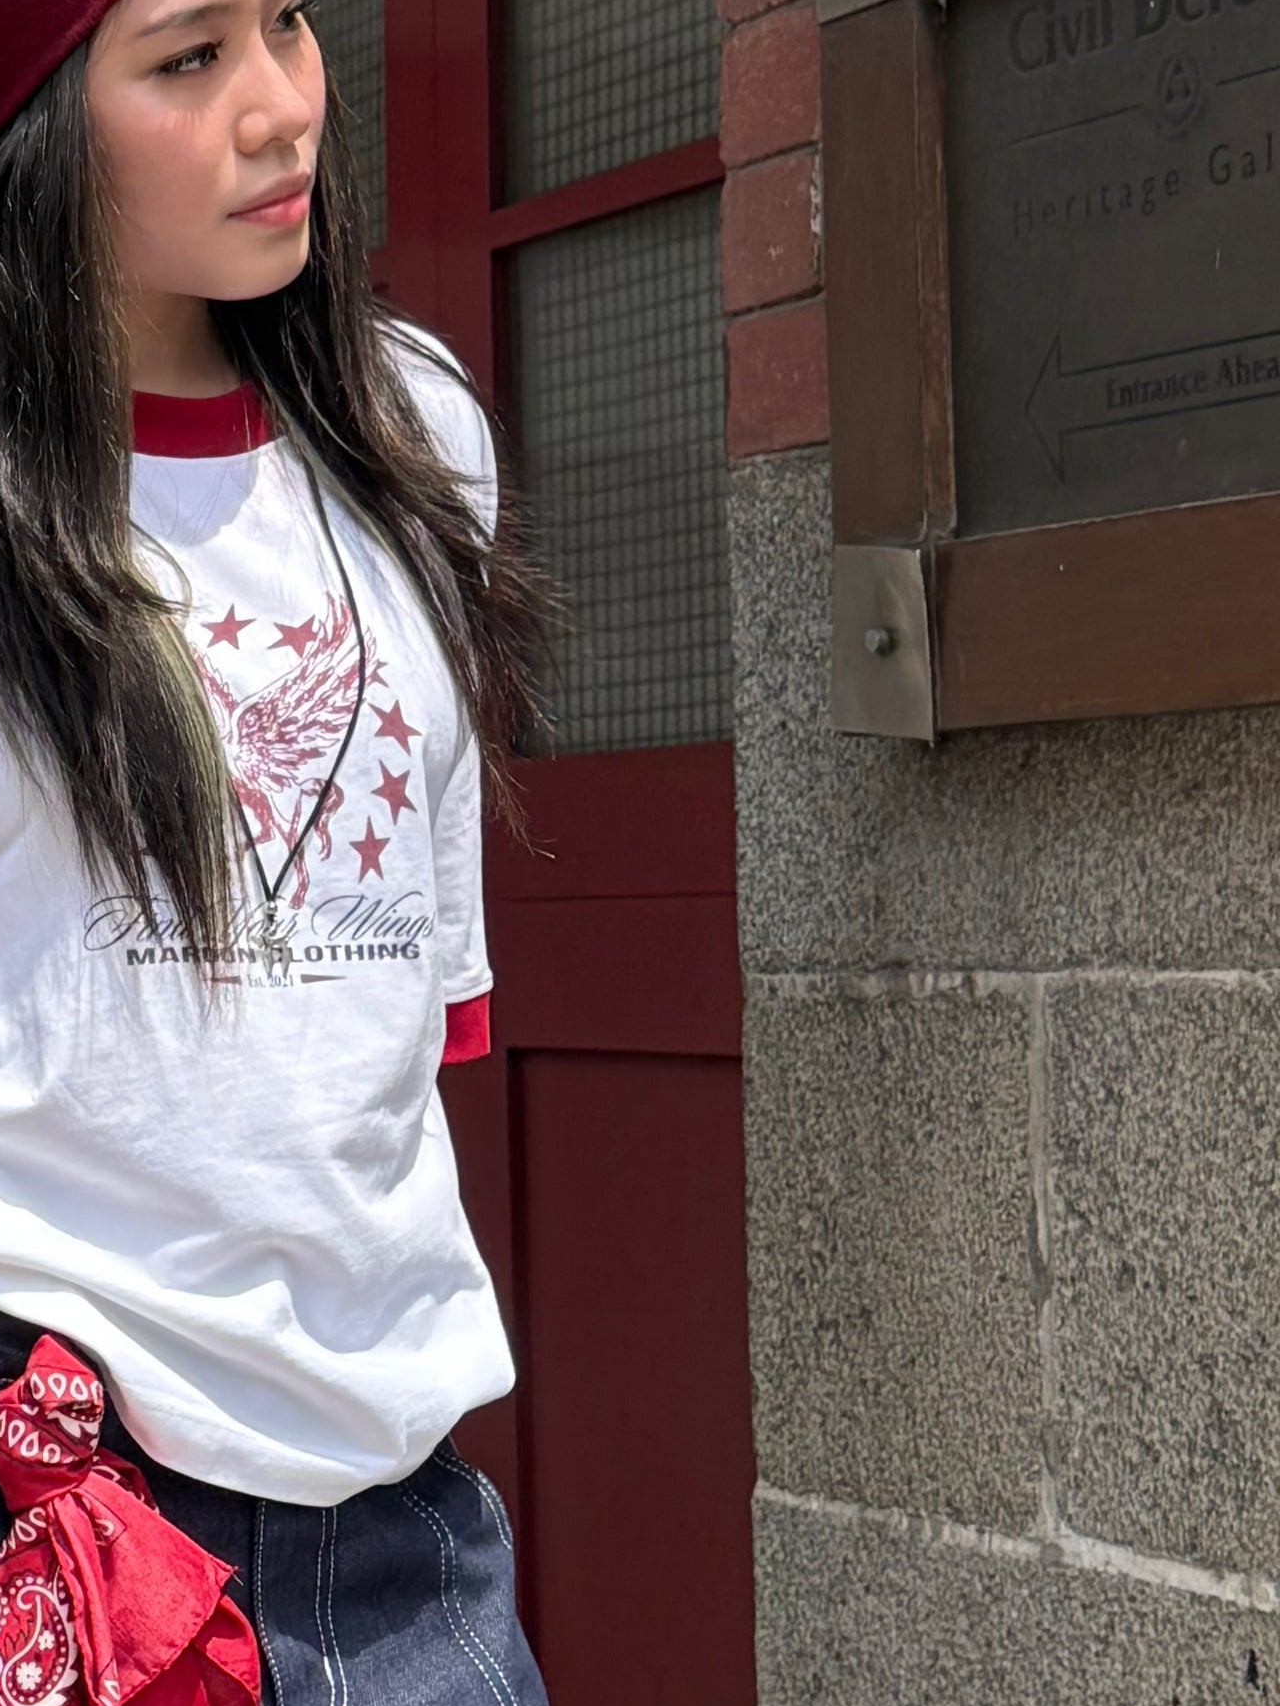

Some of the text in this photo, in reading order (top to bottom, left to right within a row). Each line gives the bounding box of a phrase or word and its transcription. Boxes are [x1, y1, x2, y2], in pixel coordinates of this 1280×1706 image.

[1013, 131, 1274, 237] Heritage Gal
[1106, 371, 1208, 411] Entrance
[311, 890, 436, 955] Wings
[266, 942, 420, 963] LOTHING
